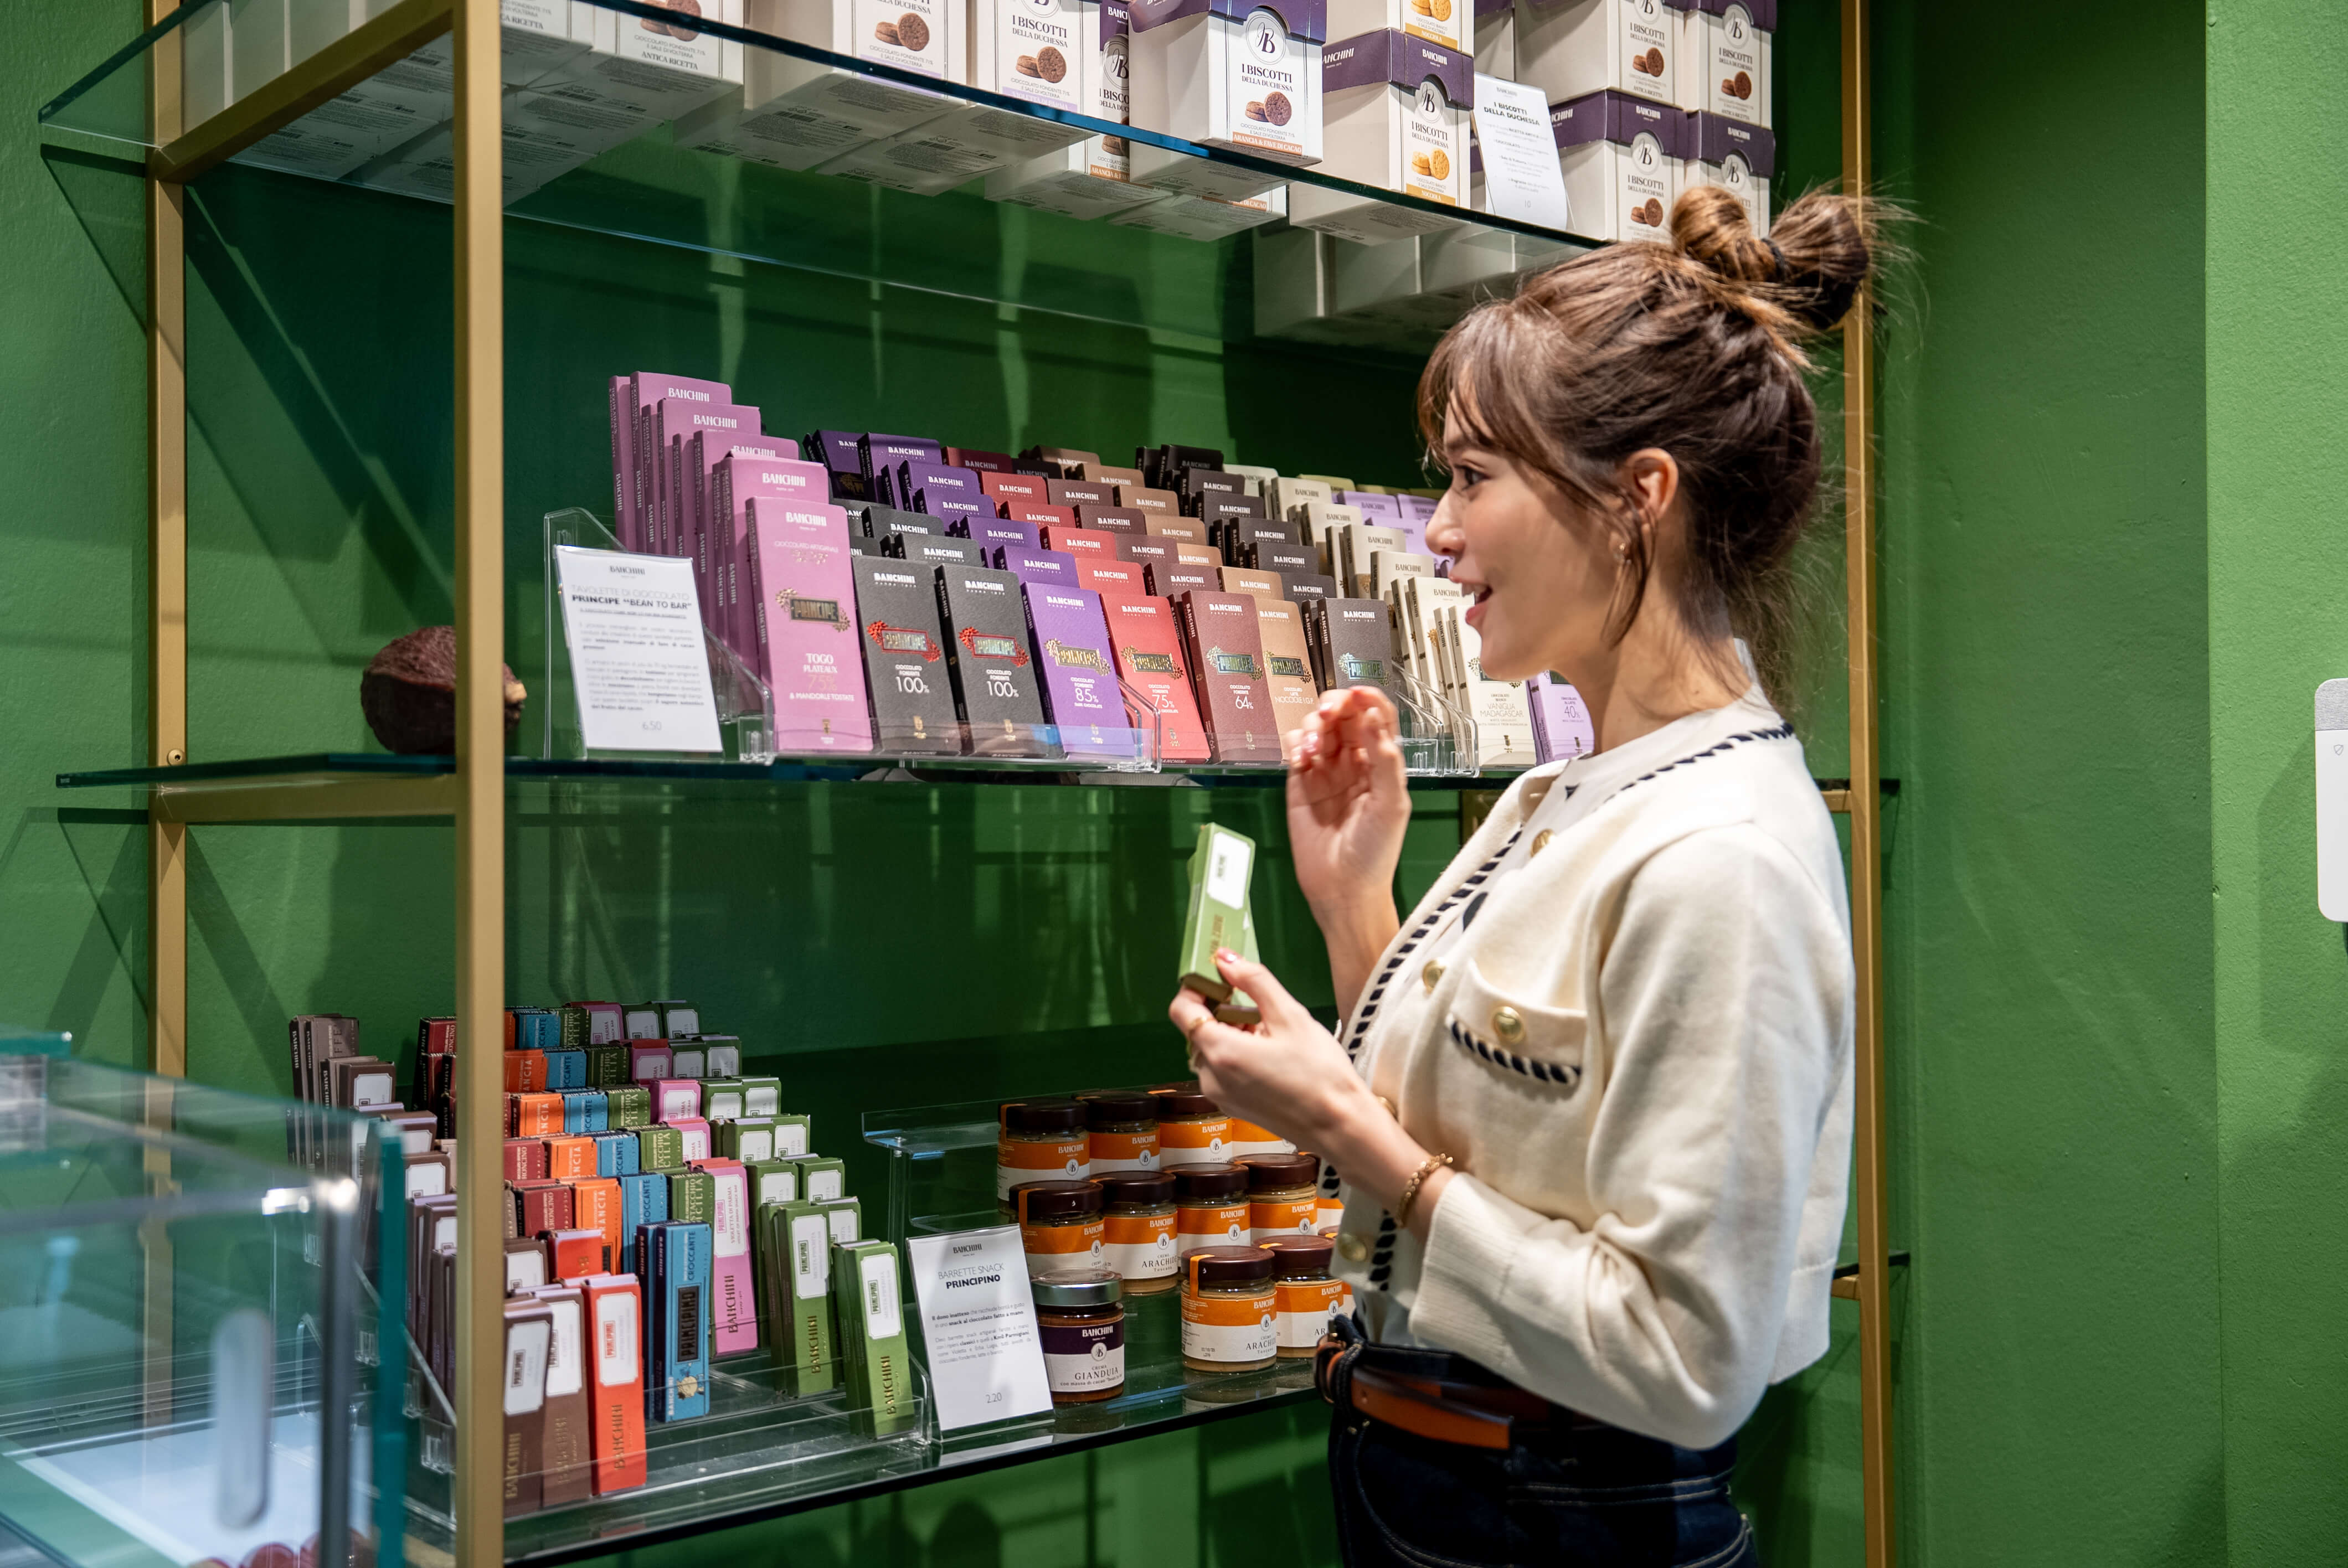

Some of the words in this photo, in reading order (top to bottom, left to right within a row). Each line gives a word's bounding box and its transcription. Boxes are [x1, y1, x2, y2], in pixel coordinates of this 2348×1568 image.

[512, 16, 544, 29] RICETTA
[1012, 15, 1015, 24] I
[1018, 16, 1067, 38] BISCOTTI
[1630, 22, 1632, 30] I
[1634, 23, 1665, 40] BISCOTTI
[1012, 28, 1033, 39] DELLA
[1034, 33, 1068, 48] DUCHESSA
[1630, 33, 1644, 42] DELLA
[1644, 37, 1665, 48] DUCHESSA
[642, 51, 668, 64] ANTICA
[669, 58, 698, 70] RICETTA
[1719, 47, 1721, 55] I
[1723, 48, 1753, 64] BISCOTTI
[1719, 58, 1732, 66] DELLA
[1732, 61, 1753, 72] DUCHESSA
[1242, 64, 1244, 73] I
[1247, 65, 1292, 83] BISCOTTI
[1242, 75, 1260, 86] DELLA
[1262, 79, 1293, 92] DUCHESSA
[1499, 103, 1527, 115] BISCOTTI
[1484, 107, 1505, 117] DELLA
[1507, 113, 1539, 126] DUCHESSA
[1412, 121, 1414, 130] I
[1416, 122, 1448, 141] BISCOTTI
[1233, 134, 1258, 145] ARANCIA
[1264, 141, 1277, 149] FAVE
[1283, 145, 1301, 153] CACAO
[1412, 132, 1425, 142] DELLA
[1426, 136, 1449, 149] DUCHESSA
[1091, 167, 1114, 177] ARANCIA
[1628, 174, 1630, 183] I
[1632, 176, 1664, 190] BISCOTTI
[1642, 188, 1664, 198] DUCHESSA
[668, 388, 709, 402] BANCHINI
[693, 415, 737, 429] BANCHINI
[888, 446, 925, 456] BANCHINI
[762, 473, 806, 487] BANCHINI
[928, 476, 964, 488] BANCHINI
[999, 484, 1032, 494] BANCHINI
[1065, 491, 1099, 501] BANCHINI
[943, 502, 979, 512] BANCHINI
[1136, 498, 1166, 507] BANCHINI
[1219, 505, 1250, 514] BANCHINI
[786, 512, 827, 527] BANCHINI
[1026, 514, 1060, 523] BANCHINI
[1098, 518, 1130, 526] BANCHINI
[890, 523, 929, 535] BANCHINI
[987, 530, 1023, 540] BANCHINI
[1162, 529, 1193, 538] BANCHINI
[1255, 530, 1285, 539] BANCHINI
[1067, 539, 1101, 548] BANCHINI
[1132, 546, 1165, 555] BANCHINI
[1024, 560, 1060, 570] BANCHINI
[1274, 556, 1305, 564] BANCHINI
[610, 566, 645, 575] BANCHINI
[1093, 570, 1128, 580] BANCHINI
[874, 572, 915, 584] BANCHINI
[1171, 575, 1204, 584] BANCHINI
[965, 580, 1004, 591] BANCHINI
[1240, 581, 1270, 590] BANCHINI
[1293, 585, 1322, 594] BANCHINI
[571, 584, 620, 595] TAVOLETTE
[633, 589, 689, 601] CIOCCOLATO
[572, 594, 620, 605] PRINCIPE
[1046, 596, 1084, 607] BANCHINI
[1121, 606, 1156, 614] BANCHINI
[1209, 604, 1242, 612] BANCHINI
[1259, 611, 1289, 619] BANCHINI
[806, 653, 833, 664] TOGO
[803, 664, 837, 673] PLATEAUX
[807, 674, 837, 691] 75%
[895, 677, 929, 693] 100%
[986, 681, 1019, 697] 100%
[1075, 689, 1099, 703] 85%
[1152, 694, 1175, 708] 75%
[1235, 695, 1254, 709] 64%
[1564, 705, 1580, 719] 40%
[1202, 1123, 1227, 1133] BANCHINI
[1132, 1135, 1156, 1144] BANCHINI
[1058, 1144, 1084, 1154] BANCHINI
[1221, 1209, 1245, 1219] BANCHINI
[1292, 1203, 1314, 1213] BANCHINI
[598, 1190, 606, 1240] ARANCIA
[717, 1202, 725, 1233] PRINCIPINO
[1150, 1218, 1173, 1227] BANCHINI
[953, 1244, 982, 1254] BANCHINI
[688, 1231, 696, 1280] CROCCANTE
[800, 1241, 810, 1274] PRINCIPINO
[1141, 1256, 1178, 1268] ARACHIDE
[938, 1267, 976, 1280] BARRETTE
[978, 1263, 1005, 1273] SNACK
[946, 1275, 1001, 1289] PRINCIPINO
[871, 1281, 880, 1314] PRINCIPINO
[682, 1290, 696, 1357] PRINCIPINO
[1082, 1325, 1113, 1337] BANCHINI
[605, 1323, 614, 1356] PRINCIPINO
[513, 1352, 524, 1385] PRINCIPINO
[1075, 1367, 1119, 1380] GIANDUIA
[986, 1392, 1002, 1404] 2.20
